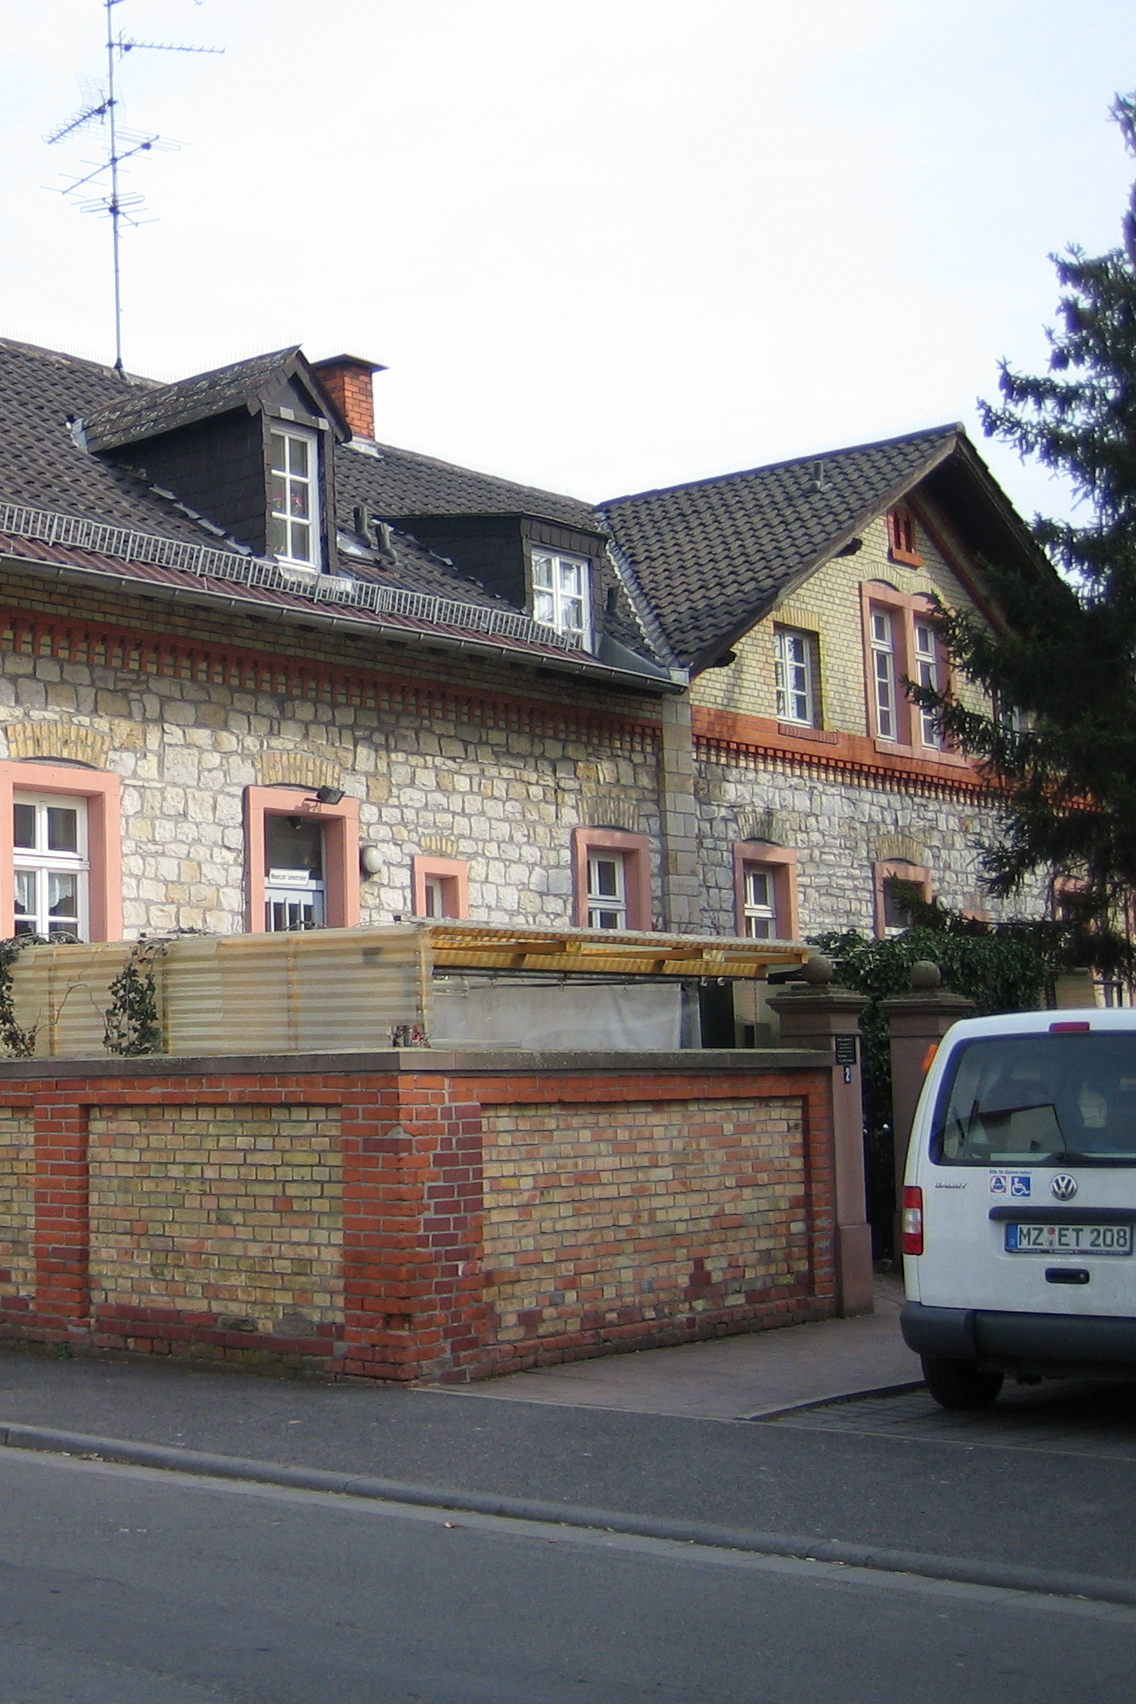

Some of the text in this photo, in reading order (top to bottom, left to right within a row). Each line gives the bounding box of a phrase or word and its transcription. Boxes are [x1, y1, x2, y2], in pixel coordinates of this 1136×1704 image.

[1018, 1226, 1128, 1248] MZ ET 208
